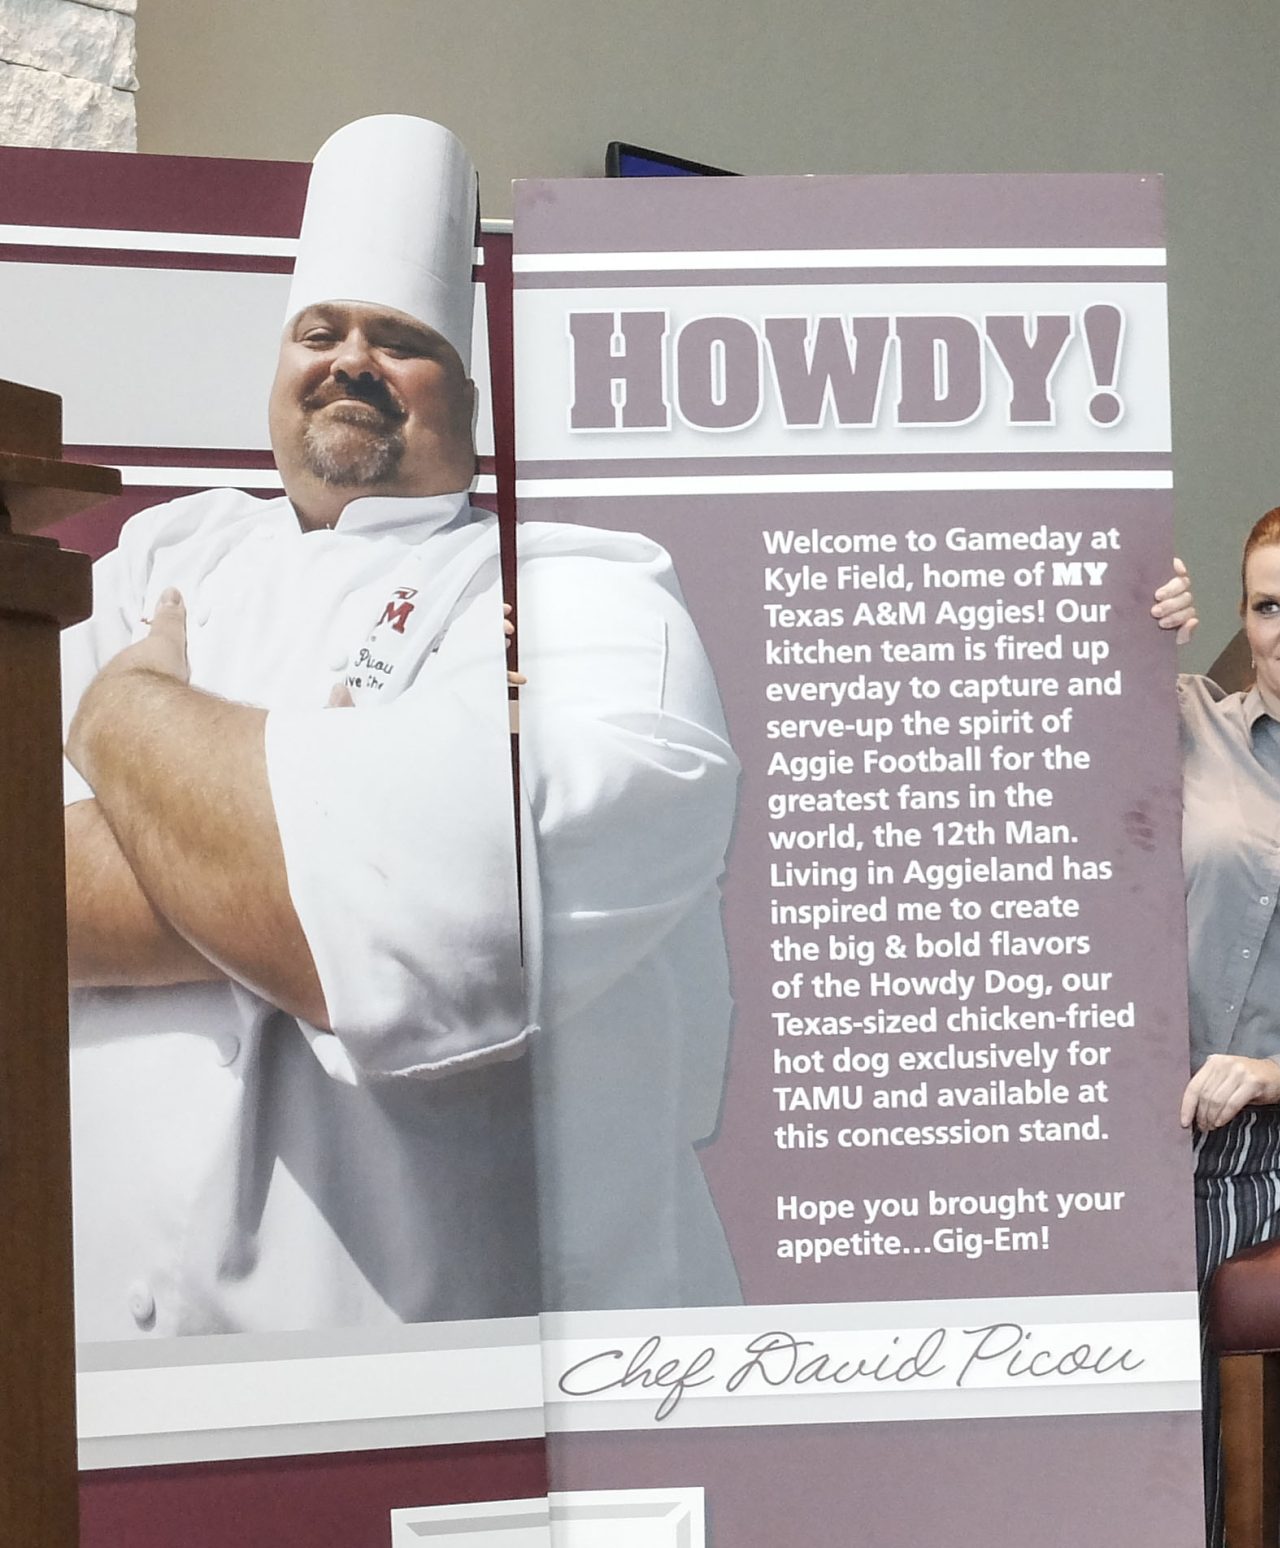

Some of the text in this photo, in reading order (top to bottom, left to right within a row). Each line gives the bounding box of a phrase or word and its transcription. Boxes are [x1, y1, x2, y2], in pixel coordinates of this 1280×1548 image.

[566, 302, 1125, 432] HOWDY!
[763, 525, 1120, 556] Welcome to Gameday at
[765, 561, 1108, 597] Kyle Field, home of MY
[764, 599, 1111, 630] Texas A&M Aggies! Our
[766, 634, 1109, 665] kitchen team is fired up
[766, 671, 1121, 706] everyday to capture and
[767, 707, 1072, 742] serve-up the spirit of
[768, 745, 1090, 781] Aggie Football for the
[768, 782, 1053, 819] greatest fans in the
[769, 820, 1077, 851] world, the 12th Man.
[771, 855, 1112, 892] Living in Aggieland has
[772, 896, 1079, 929] inspired me to create
[771, 931, 1090, 966] the big & bold flavors
[772, 969, 1112, 1000] of the Howdy Dog, our
[772, 1002, 1134, 1036] Texas-sized chicken-fried
[774, 1041, 1111, 1077] hot dog exclusively for
[773, 1079, 1108, 1111] TAMU and available at
[774, 1115, 1108, 1149] this concesssion stand.
[778, 1188, 1125, 1225] Hope you brought your
[559, 1323, 1145, 1421] Chef David Picou
